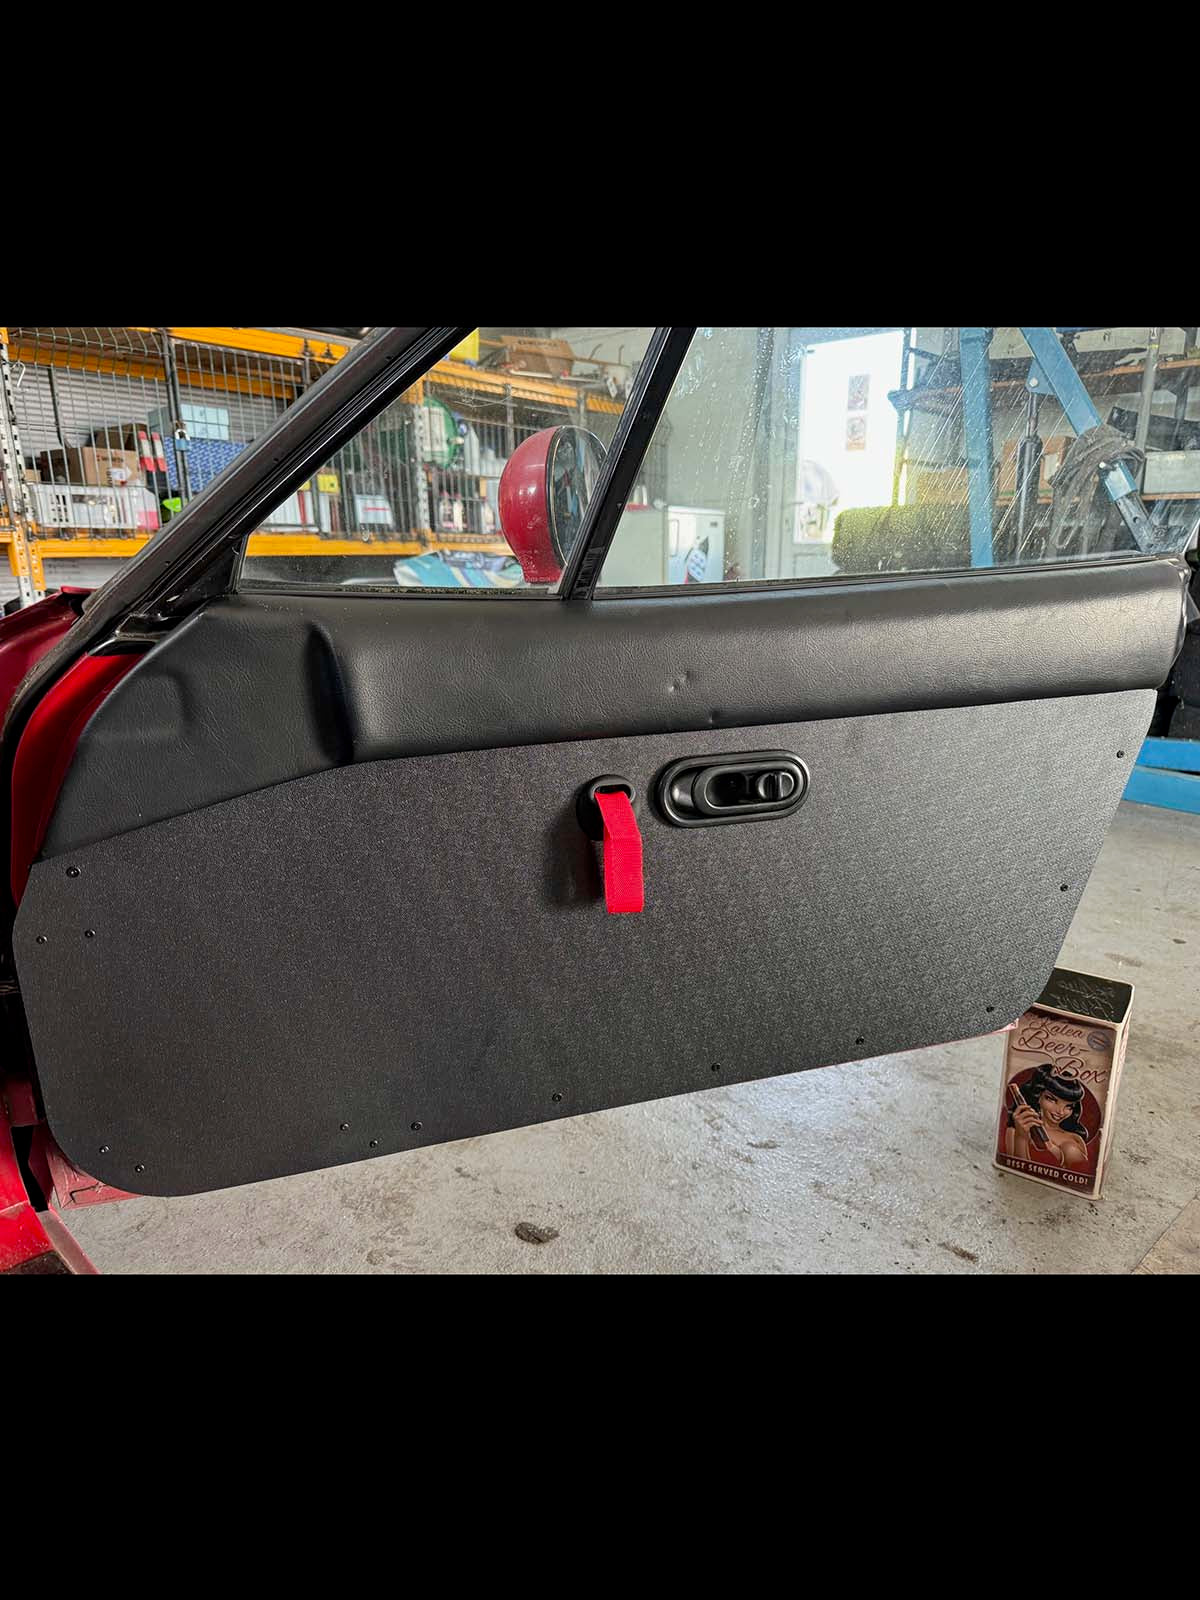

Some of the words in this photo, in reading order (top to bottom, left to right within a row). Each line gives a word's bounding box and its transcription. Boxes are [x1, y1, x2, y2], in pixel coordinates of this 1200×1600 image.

[1018, 1027, 1089, 1056] Beer
[1054, 1055, 1107, 1083] Box
[1006, 1158, 1026, 1169] BEST
[1028, 1164, 1060, 1178] SERVED
[1062, 1173, 1088, 1185] COLD!
